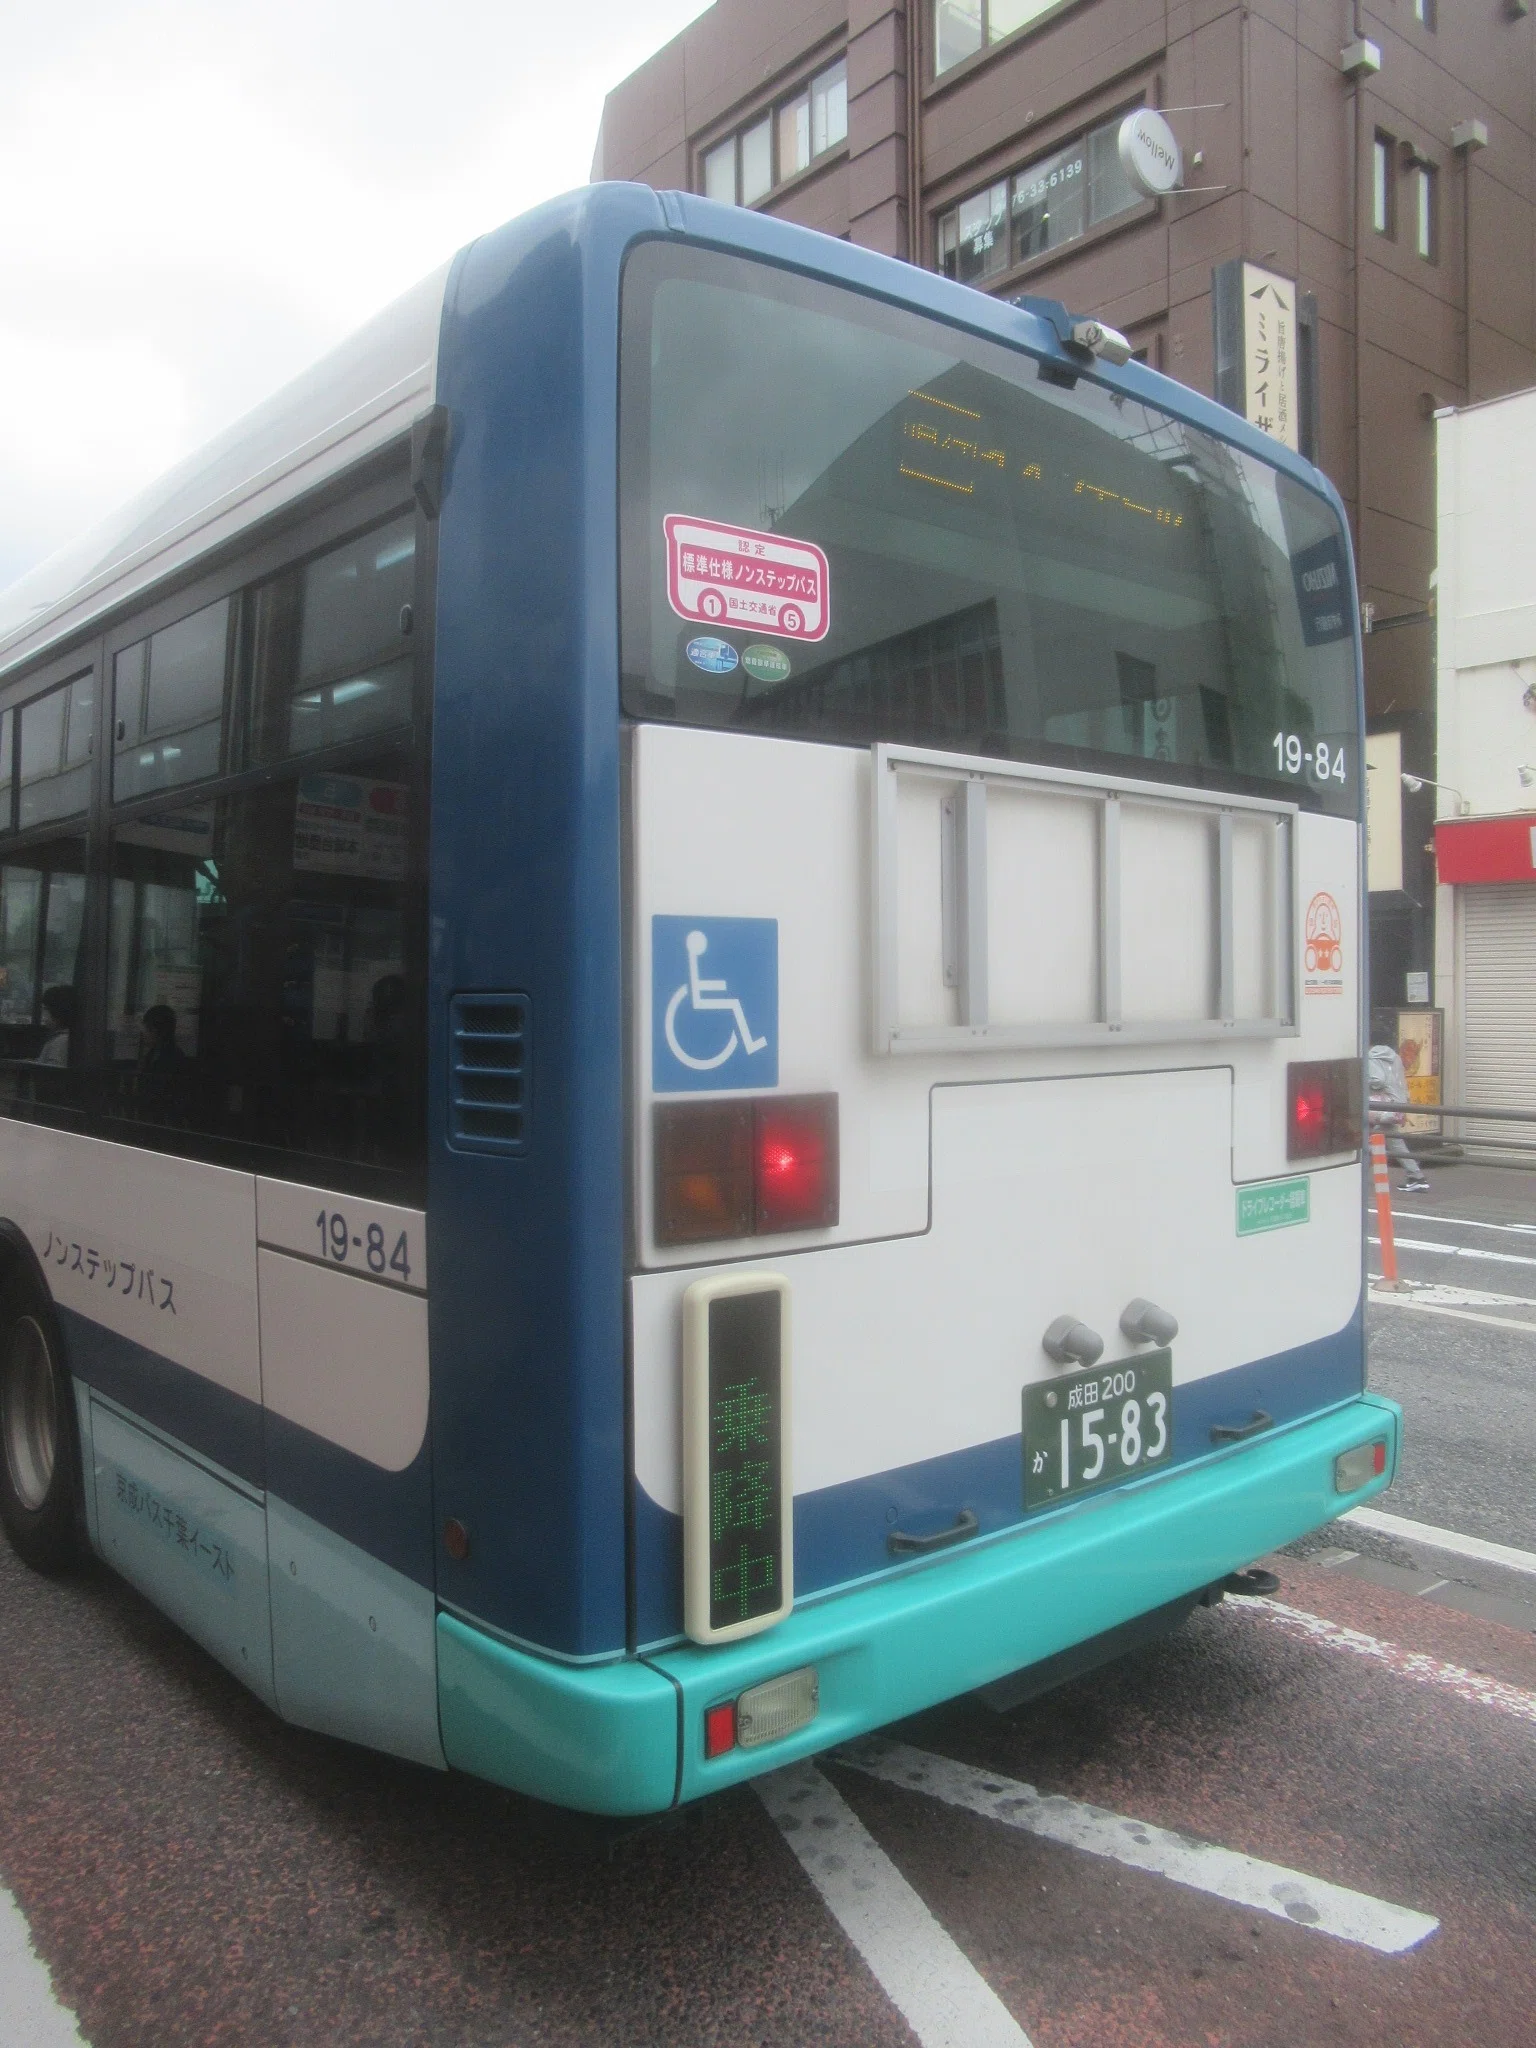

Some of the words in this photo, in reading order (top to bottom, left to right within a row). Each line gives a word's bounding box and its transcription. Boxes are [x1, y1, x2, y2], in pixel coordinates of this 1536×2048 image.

[1138, 129, 1175, 170] Mellow
[973, 231, 994, 255] 募集
[738, 540, 765, 557] 認定
[682, 552, 817, 596] 標準仕様ノンステップバス
[729, 597, 777, 617] 国土交通省
[1273, 731, 1346, 783] 19-84
[316, 1209, 411, 1282] 19-84
[43, 1231, 177, 1315] ノンステップバス
[1068, 1382, 1098, 1410] 成田
[1102, 1370, 1135, 1400] 200
[1032, 1450, 1048, 1474] か
[1060, 1391, 1167, 1489] 15-83
[713, 1376, 772, 1616] 乗降中
